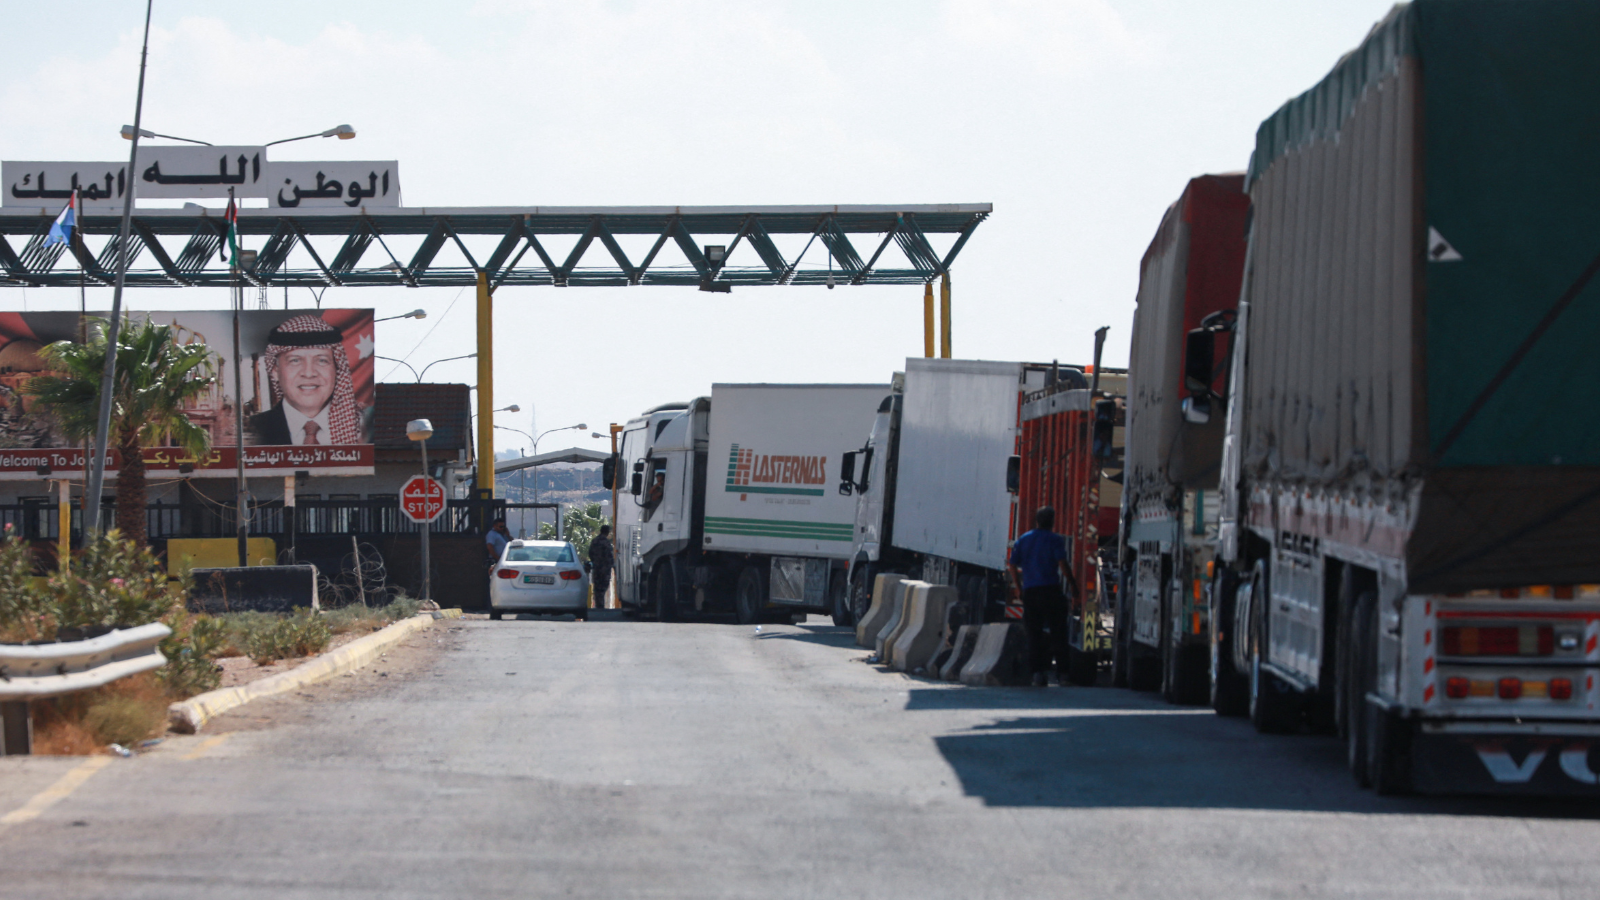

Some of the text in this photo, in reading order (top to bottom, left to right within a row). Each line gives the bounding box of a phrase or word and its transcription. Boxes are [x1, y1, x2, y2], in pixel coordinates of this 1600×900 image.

[142, 152, 260, 185] الله
[11, 166, 126, 201] الملك
[277, 169, 389, 208] الوطن
[51, 453, 67, 466] To
[69, 454, 114, 466] Jon
[142, 451, 170, 468] بك
[242, 450, 285, 466] الهاشمية
[287, 448, 327, 465] الأردنية
[329, 449, 361, 462] المملكة
[751, 454, 827, 485] LASTERNAS
[404, 483, 441, 498] قف
[408, 502, 440, 513] STOP
